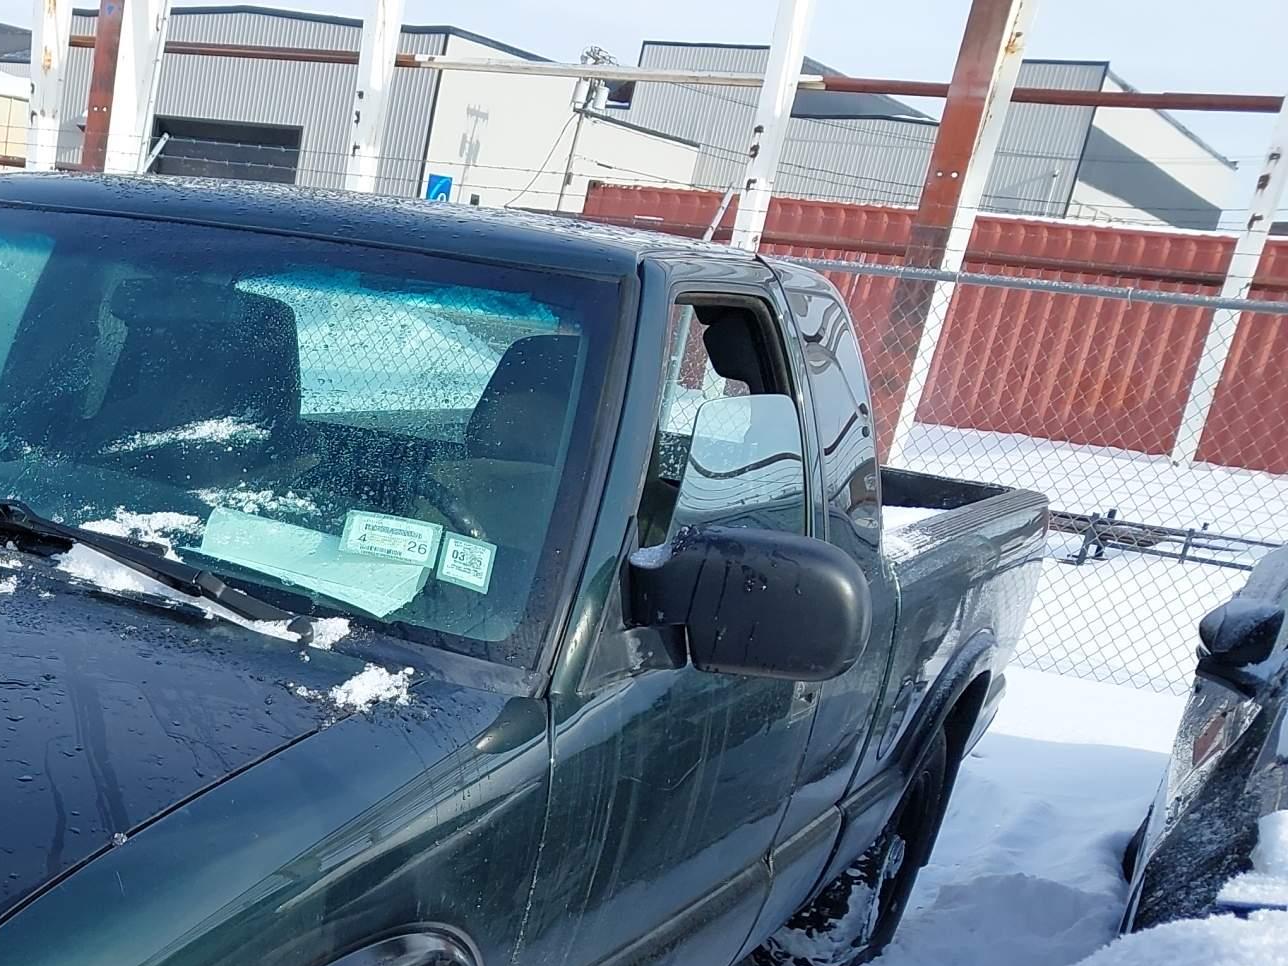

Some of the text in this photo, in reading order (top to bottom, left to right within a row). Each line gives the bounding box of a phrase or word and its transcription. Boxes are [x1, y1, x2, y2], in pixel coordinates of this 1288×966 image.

[357, 533, 368, 542] 4
[407, 540, 428, 555] 26
[451, 549, 466, 562] 03
